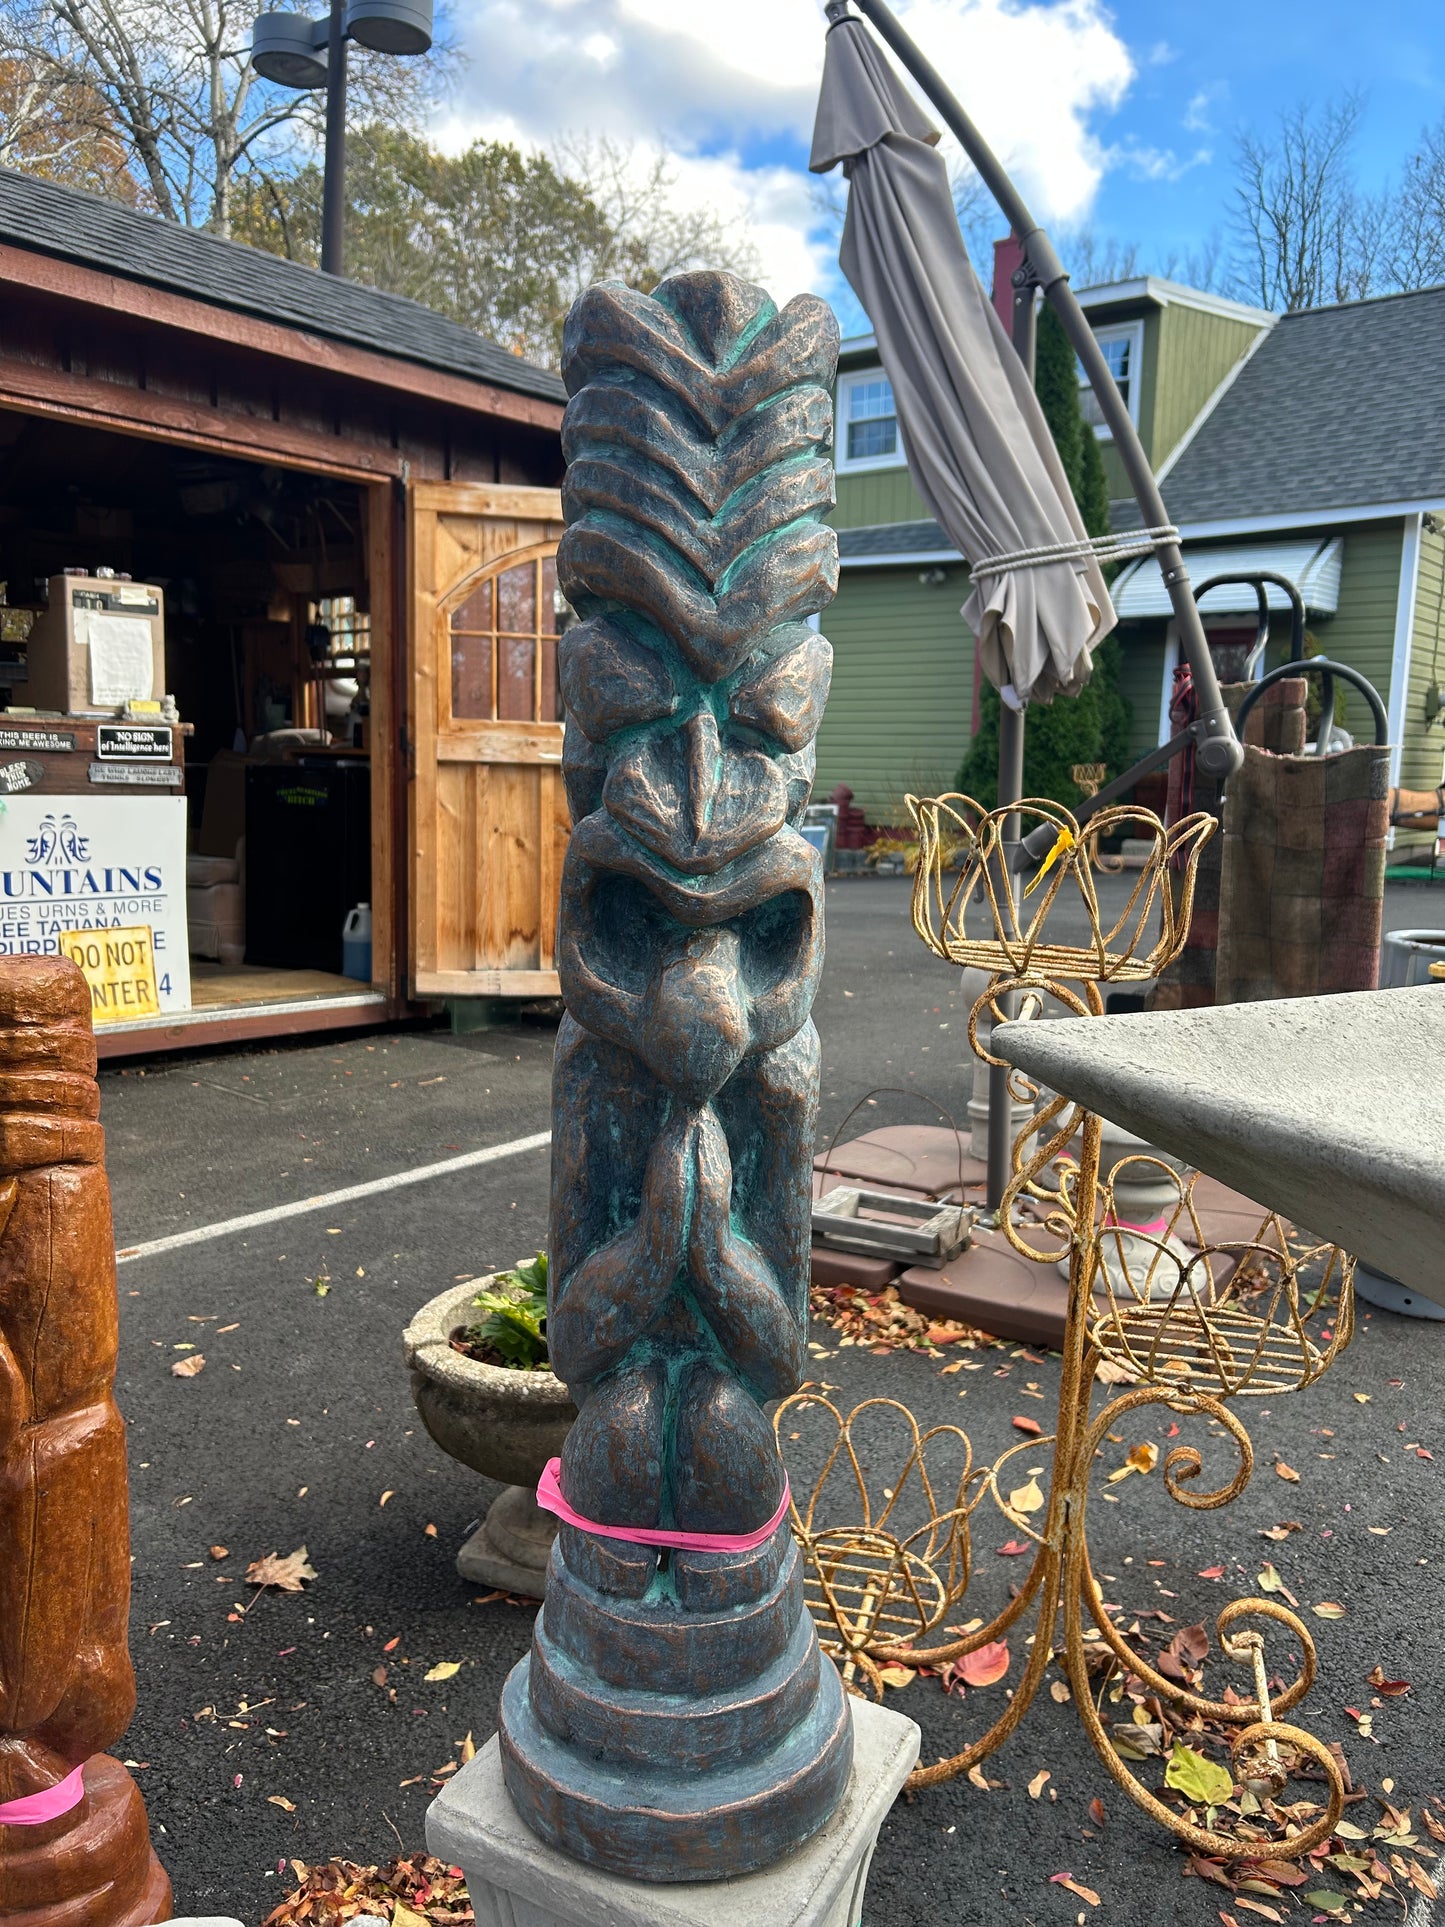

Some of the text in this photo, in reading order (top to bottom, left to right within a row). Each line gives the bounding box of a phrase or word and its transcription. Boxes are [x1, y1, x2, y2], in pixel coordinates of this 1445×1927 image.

[0, 731, 19, 739] THIS
[22, 732, 47, 740] BEER
[117, 732, 155, 742] NO SIGN
[19, 739, 31, 747] ME
[32, 740, 72, 749] AWESOME
[101, 741, 169, 753] of Intelligence here
[39, 903, 89, 918] URNS
[96, 902, 106, 915] &
[114, 899, 163, 915] MORE
[0, 921, 31, 938] EE
[70, 941, 147, 969] DO NOT
[159, 973, 172, 995] 4
